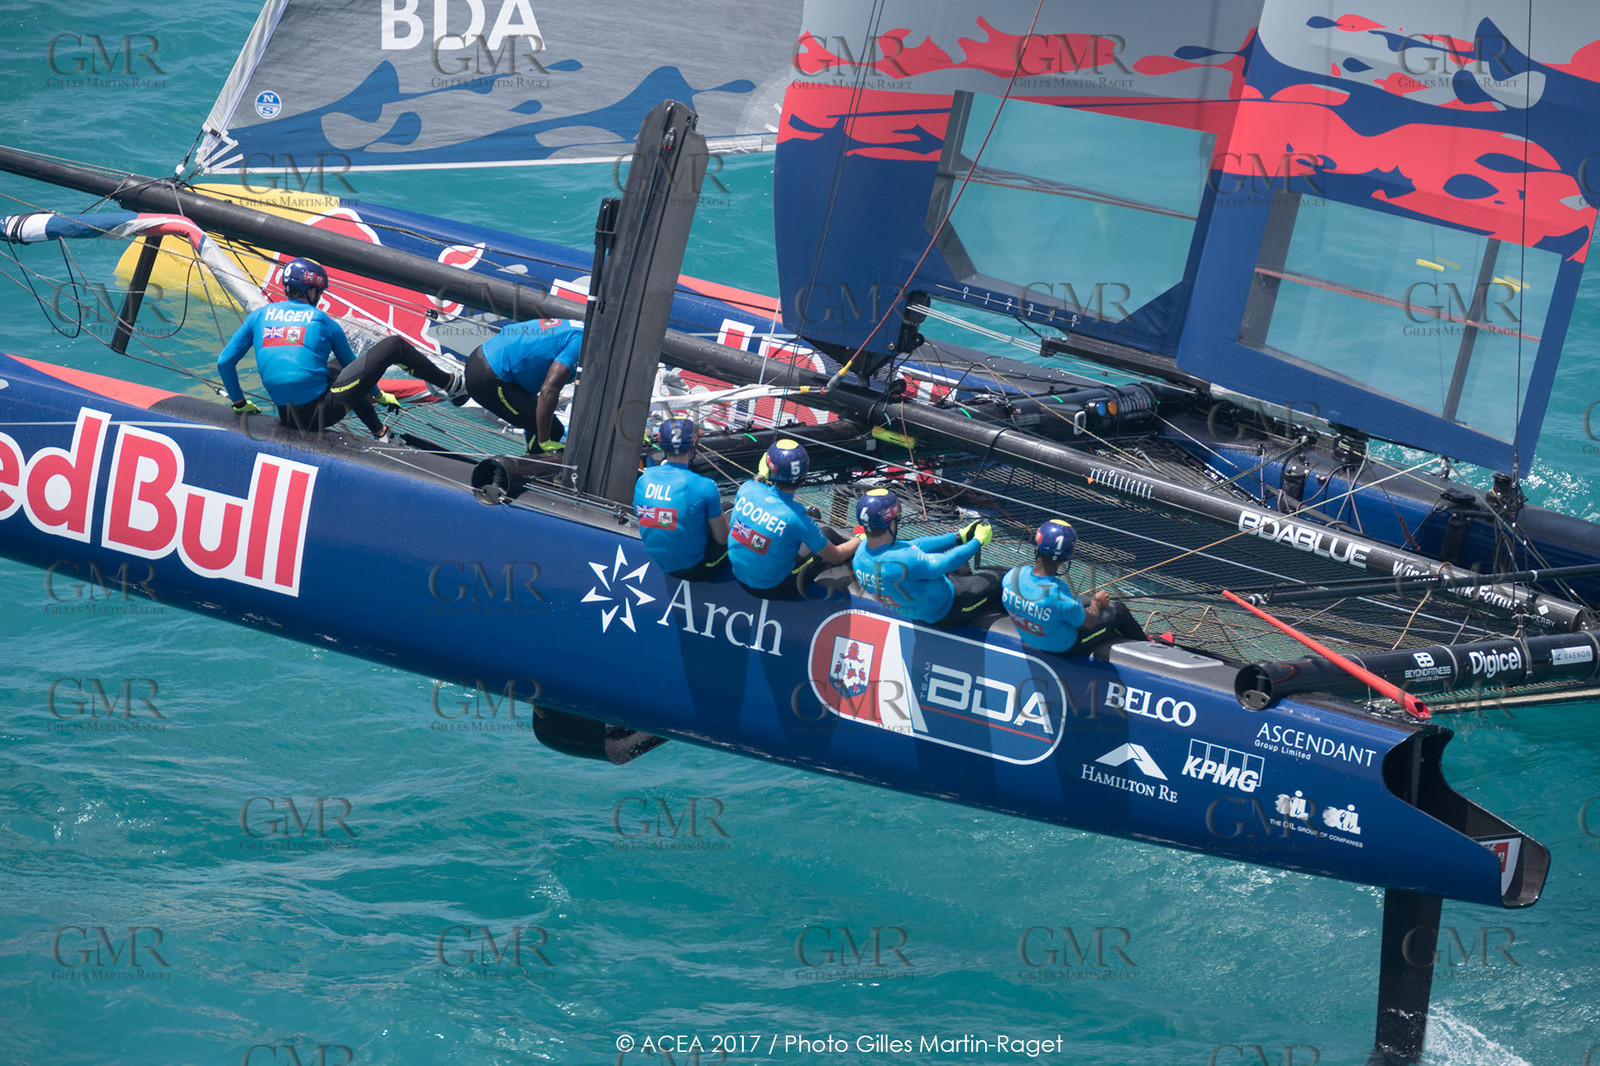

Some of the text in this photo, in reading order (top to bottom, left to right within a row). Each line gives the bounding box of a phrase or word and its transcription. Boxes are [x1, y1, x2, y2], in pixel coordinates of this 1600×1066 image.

[381, 0, 546, 50] BDA
[284, 263, 293, 277] 6
[265, 308, 314, 323] HAGEN
[671, 428, 682, 443] 2
[790, 460, 801, 475] 5
[101, 424, 319, 597] Bull
[645, 484, 672, 501] DILL
[735, 497, 787, 537] COOPER
[860, 507, 869, 522] 4
[1055, 535, 1065, 550] 1
[1238, 510, 1372, 569] BDABLUE
[657, 580, 783, 656] Arch
[1002, 587, 1052, 621] STEVENS
[919, 661, 932, 700] TEAM
[1468, 646, 1522, 679] Digicel
[926, 664, 1054, 735] BDA
[1104, 681, 1197, 727] BELCO
[1254, 739, 1312, 761] Group Limited
[1256, 722, 1377, 767] ASCENDANT
[1181, 755, 1259, 793] KPMG
